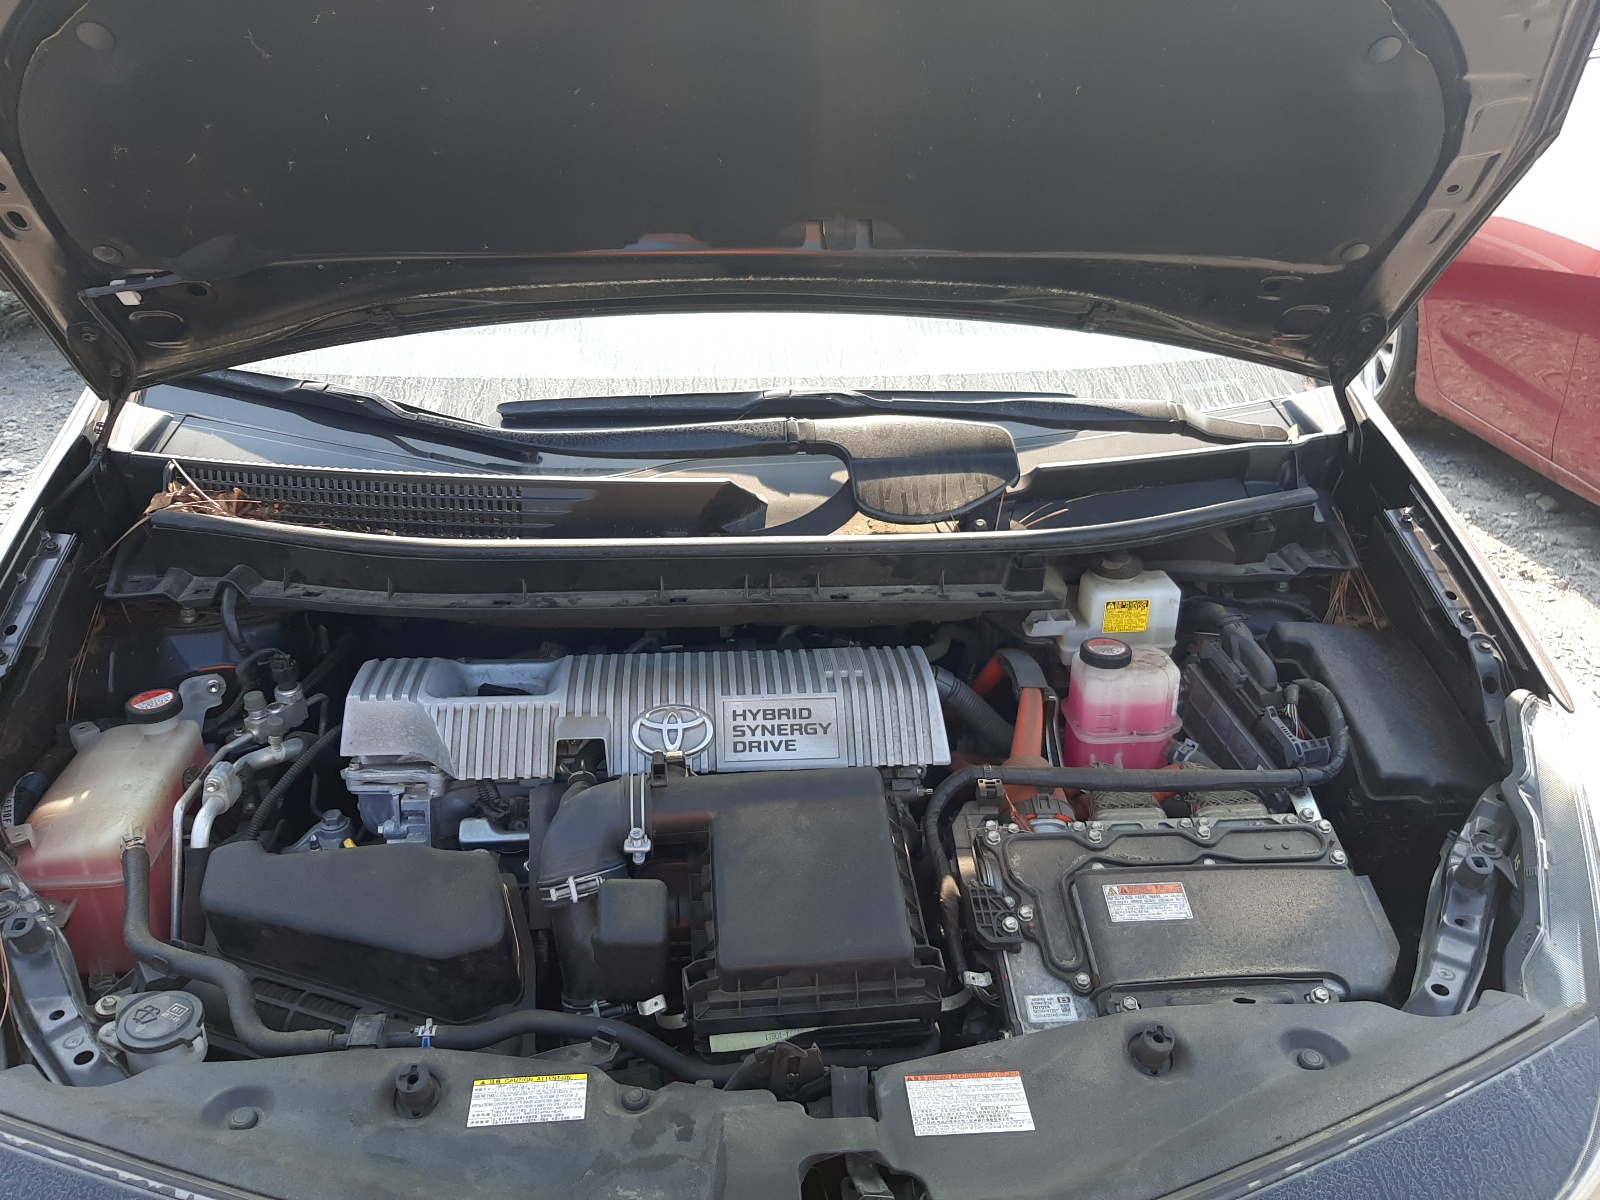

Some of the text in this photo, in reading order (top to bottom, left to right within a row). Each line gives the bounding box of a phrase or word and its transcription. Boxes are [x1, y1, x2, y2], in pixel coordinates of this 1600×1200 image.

[732, 708, 812, 721] HYBRID
[732, 723, 832, 737] SYNERGY
[732, 739, 797, 753] DRIVE
